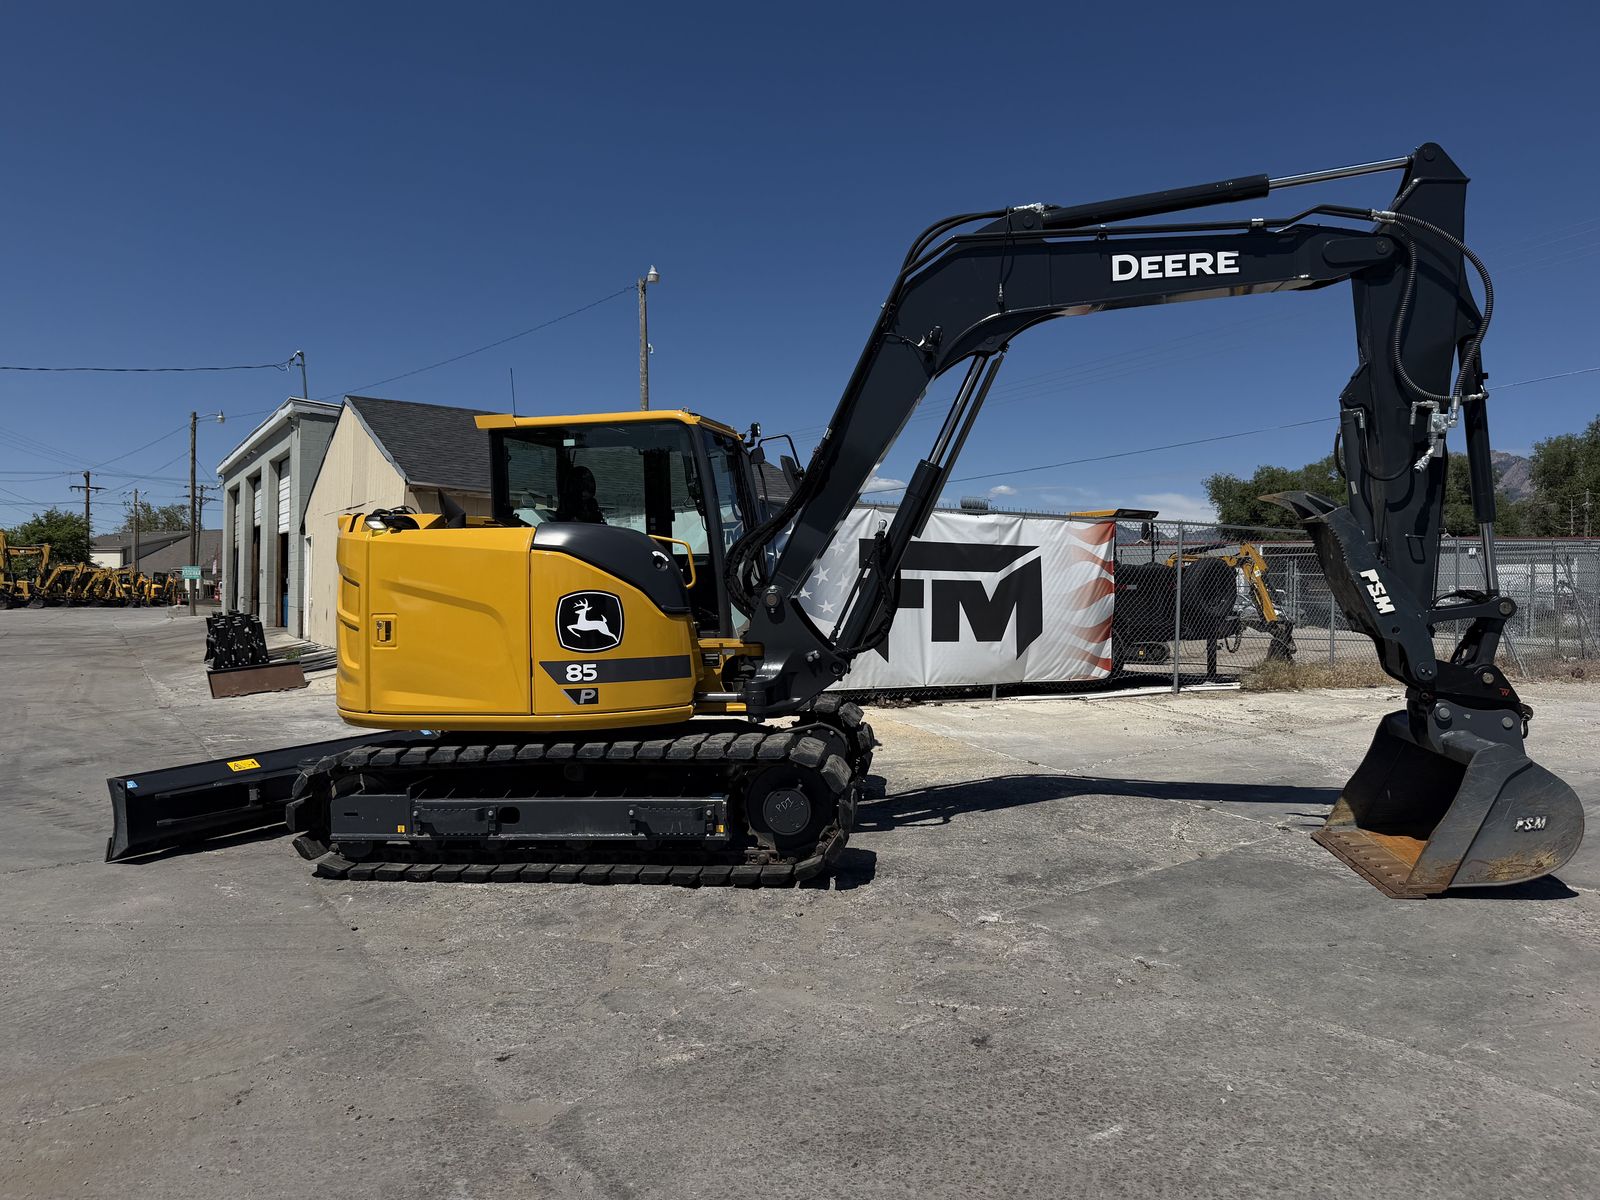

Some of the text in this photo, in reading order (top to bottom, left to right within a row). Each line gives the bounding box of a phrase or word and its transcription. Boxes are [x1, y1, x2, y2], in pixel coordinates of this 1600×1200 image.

[1112, 251, 1239, 281] DEERE
[1360, 569, 1396, 614] PSM
[566, 664, 598, 682] 85
[579, 689, 596, 704] P
[1515, 816, 1547, 830] PSM
